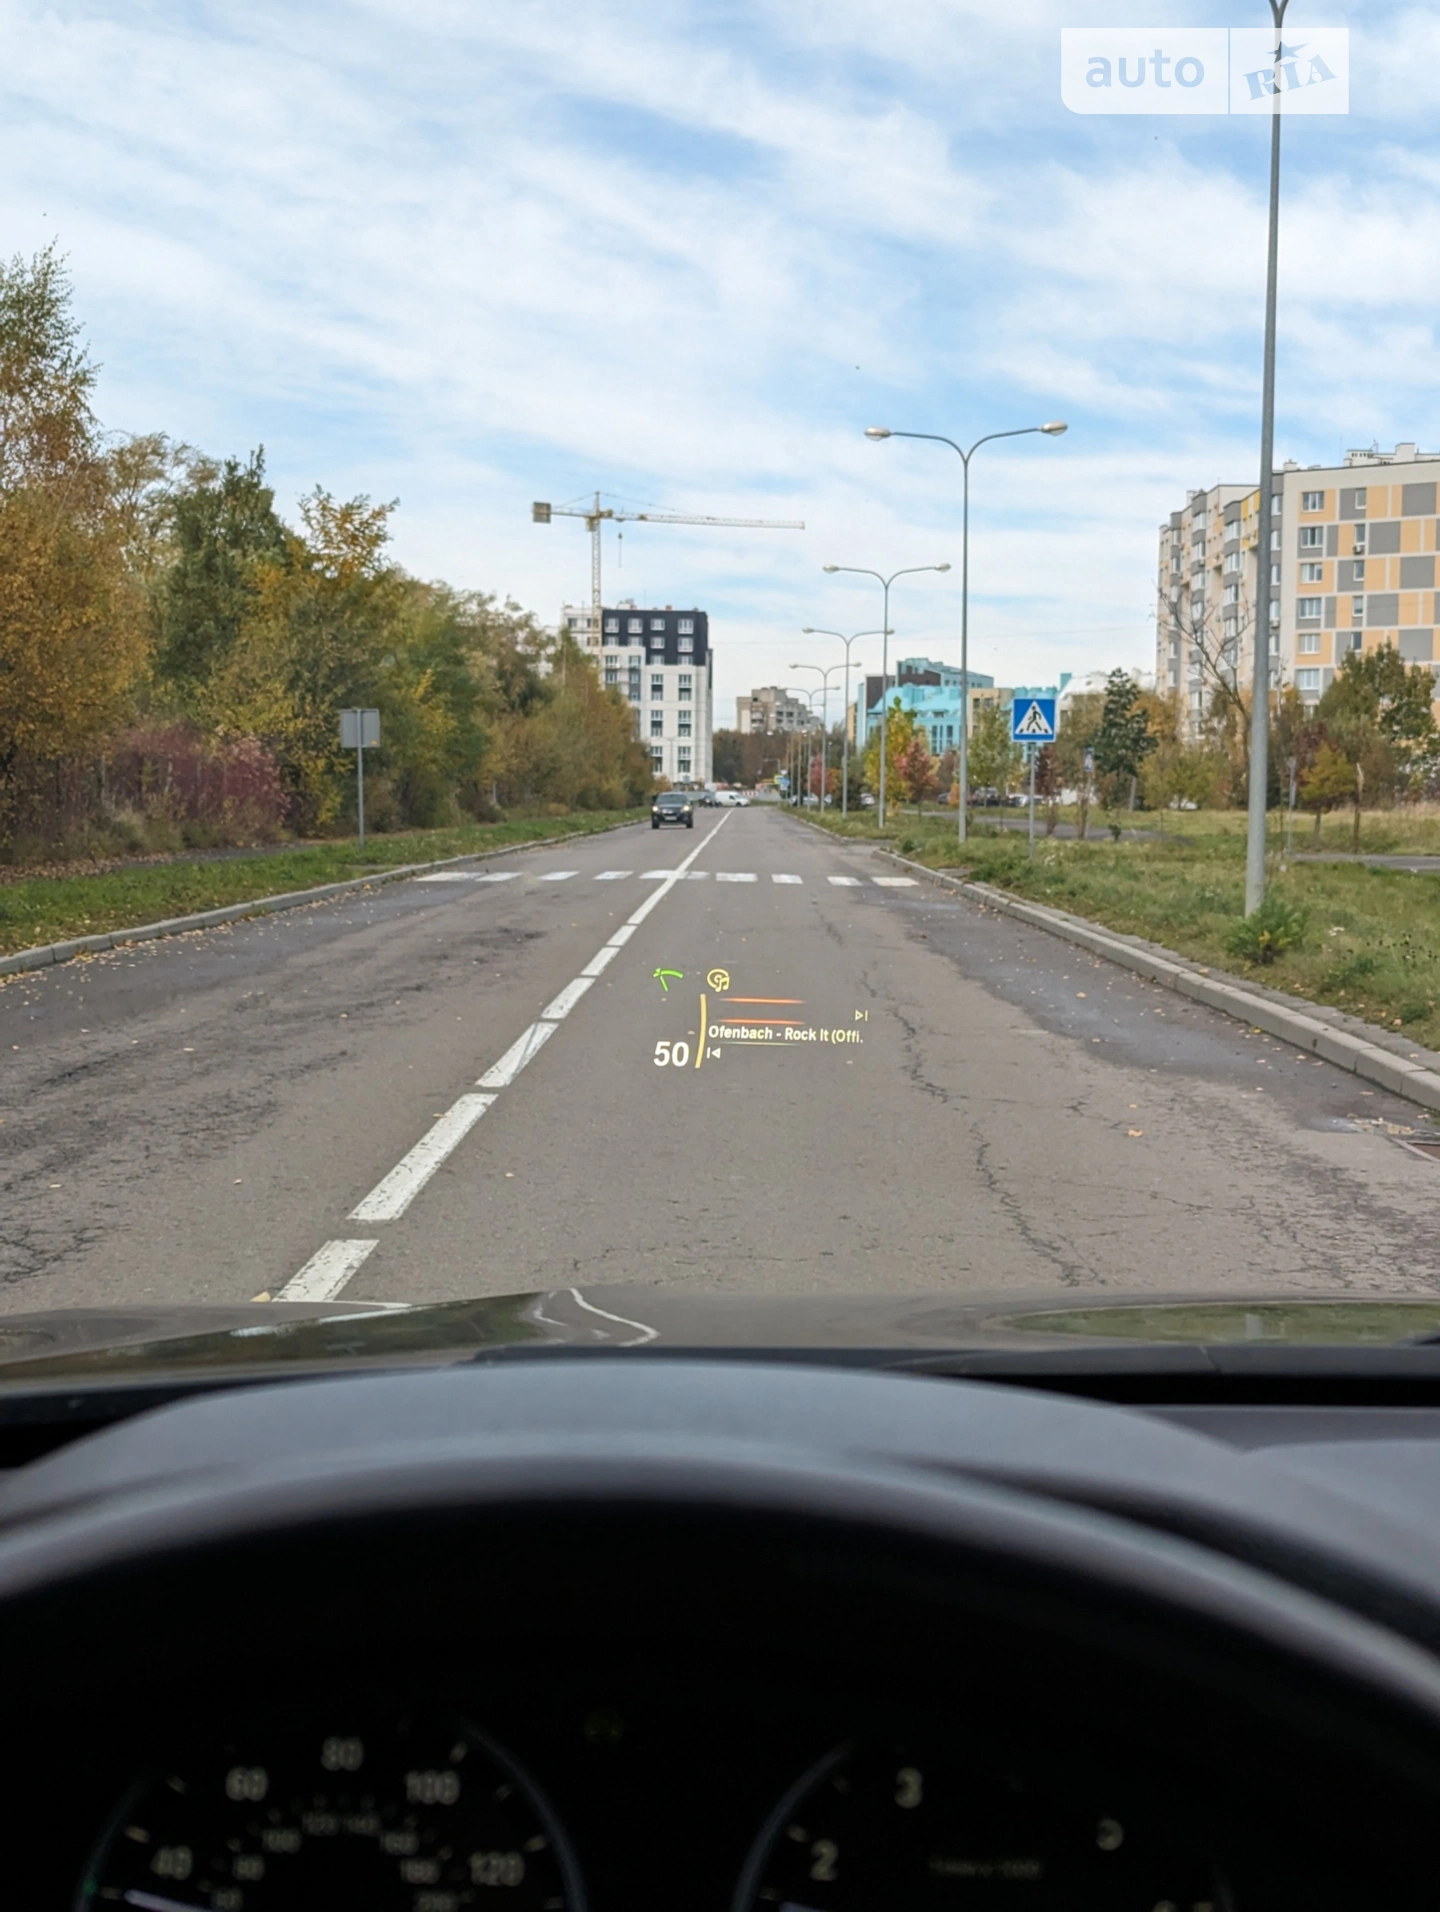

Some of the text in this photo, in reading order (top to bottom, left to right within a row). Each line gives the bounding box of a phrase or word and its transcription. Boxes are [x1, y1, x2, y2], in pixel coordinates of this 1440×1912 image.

[708, 1025, 773, 1040] Ofenbach
[784, 1027, 817, 1042] Rock
[819, 1028, 829, 1042] It
[653, 1041, 690, 1067] 50
[810, 1838, 839, 1881] 2
